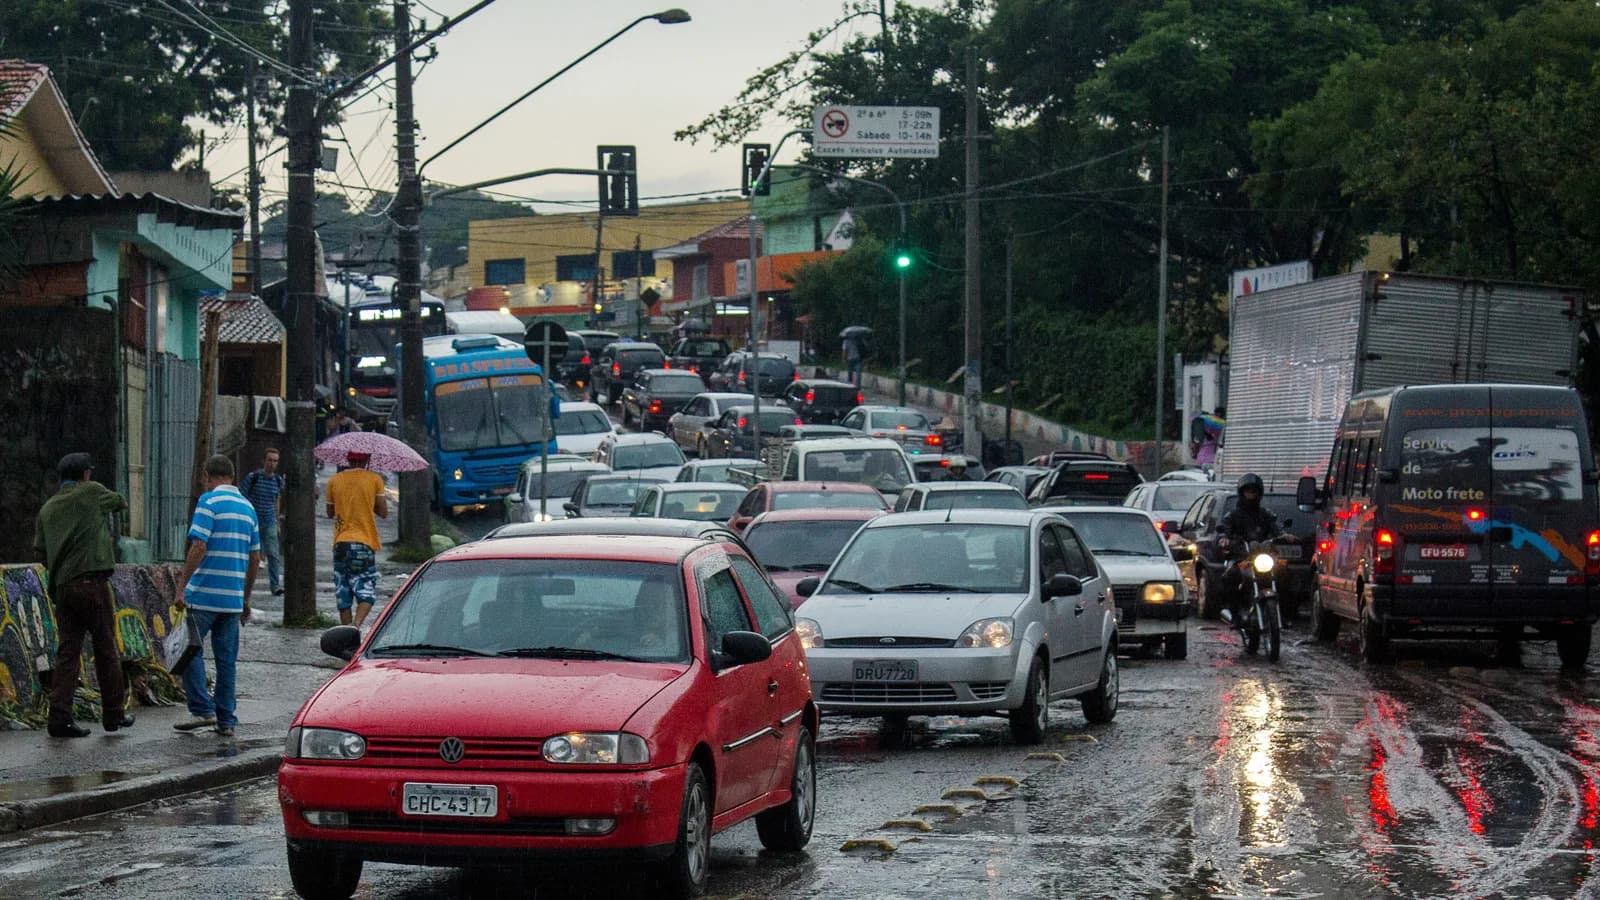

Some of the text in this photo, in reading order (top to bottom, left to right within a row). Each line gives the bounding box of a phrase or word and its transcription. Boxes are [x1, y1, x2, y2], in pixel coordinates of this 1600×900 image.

[434, 358, 537, 378] BRASPRESS
[1402, 461, 1422, 475] de
[1402, 486, 1485, 500] Moto frete
[1420, 547, 1465, 558] EFU-5576
[855, 668, 914, 681] DRU-7720
[408, 795, 491, 813] CHC-4317
